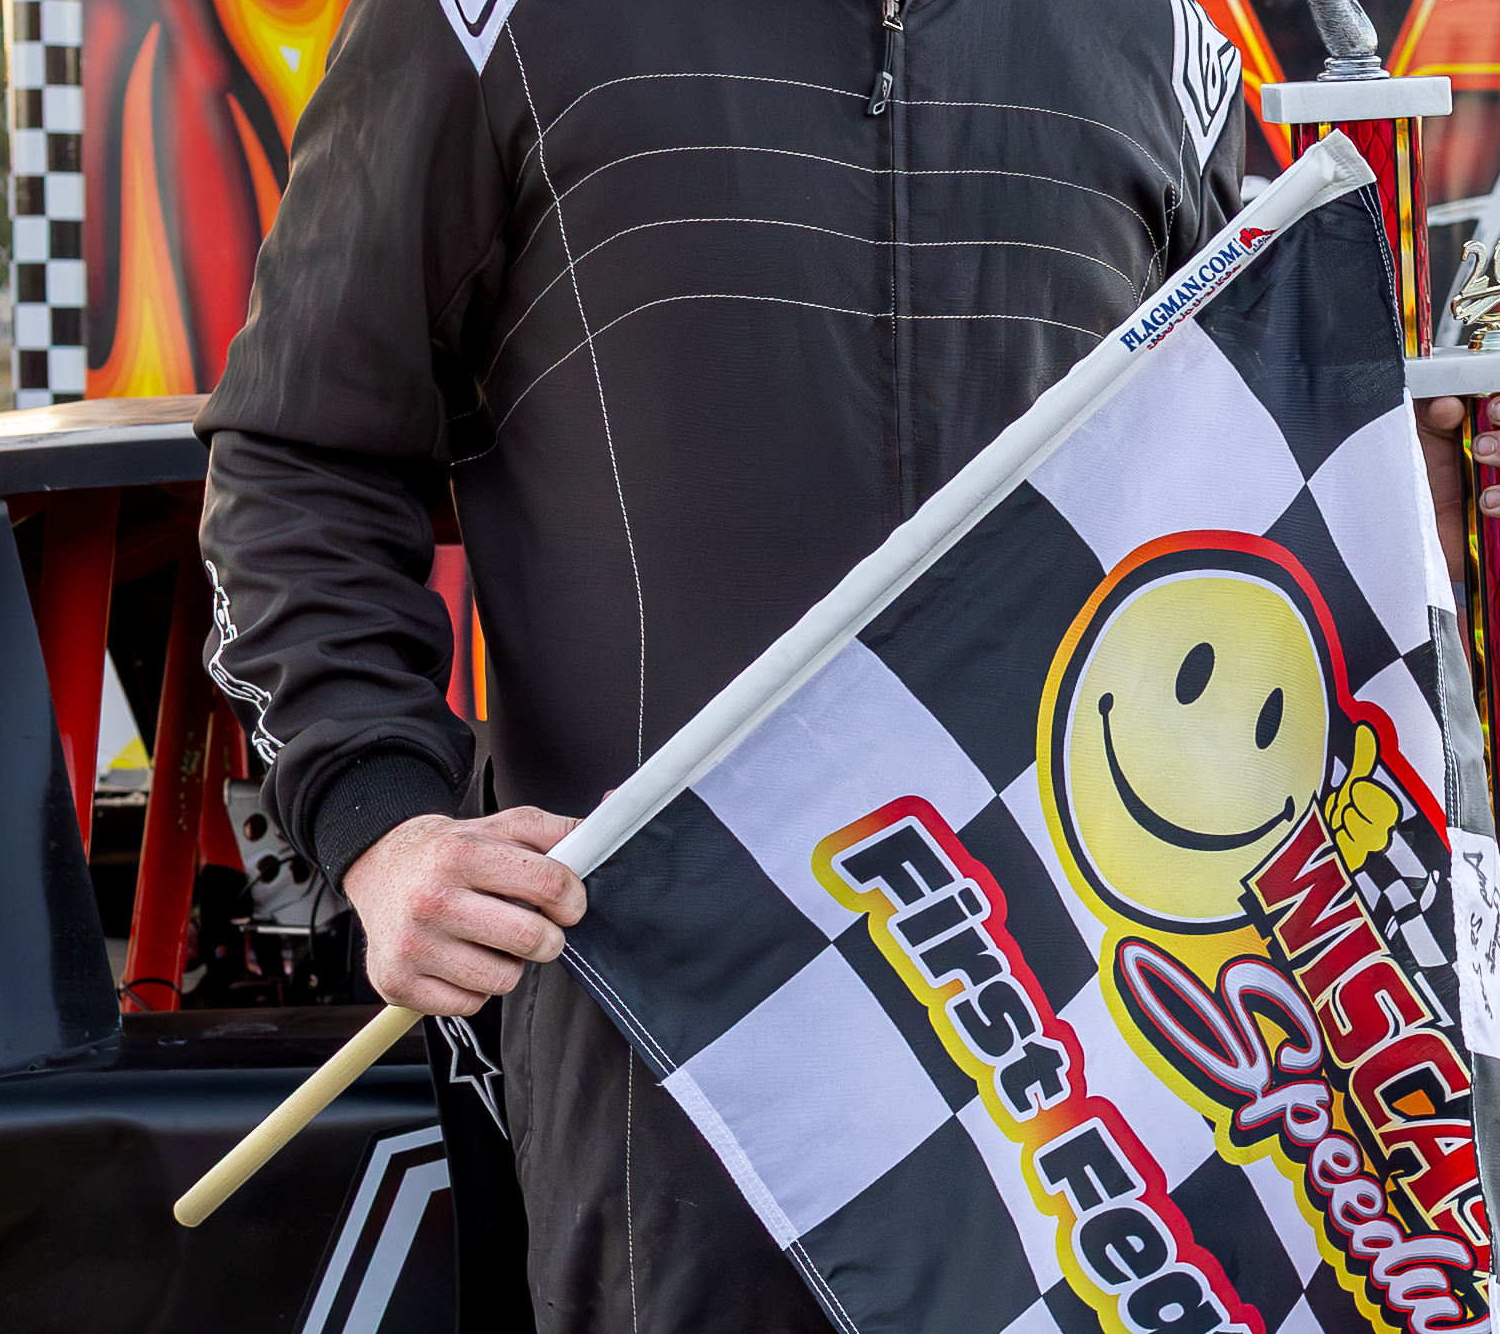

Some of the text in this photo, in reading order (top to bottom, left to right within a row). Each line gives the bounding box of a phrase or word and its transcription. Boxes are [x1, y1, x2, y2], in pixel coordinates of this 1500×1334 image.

[1119, 241, 1243, 353] FLAGMAN.COM
[840, 824, 1066, 1114] First
[1244, 795, 1492, 1297] WISCA
